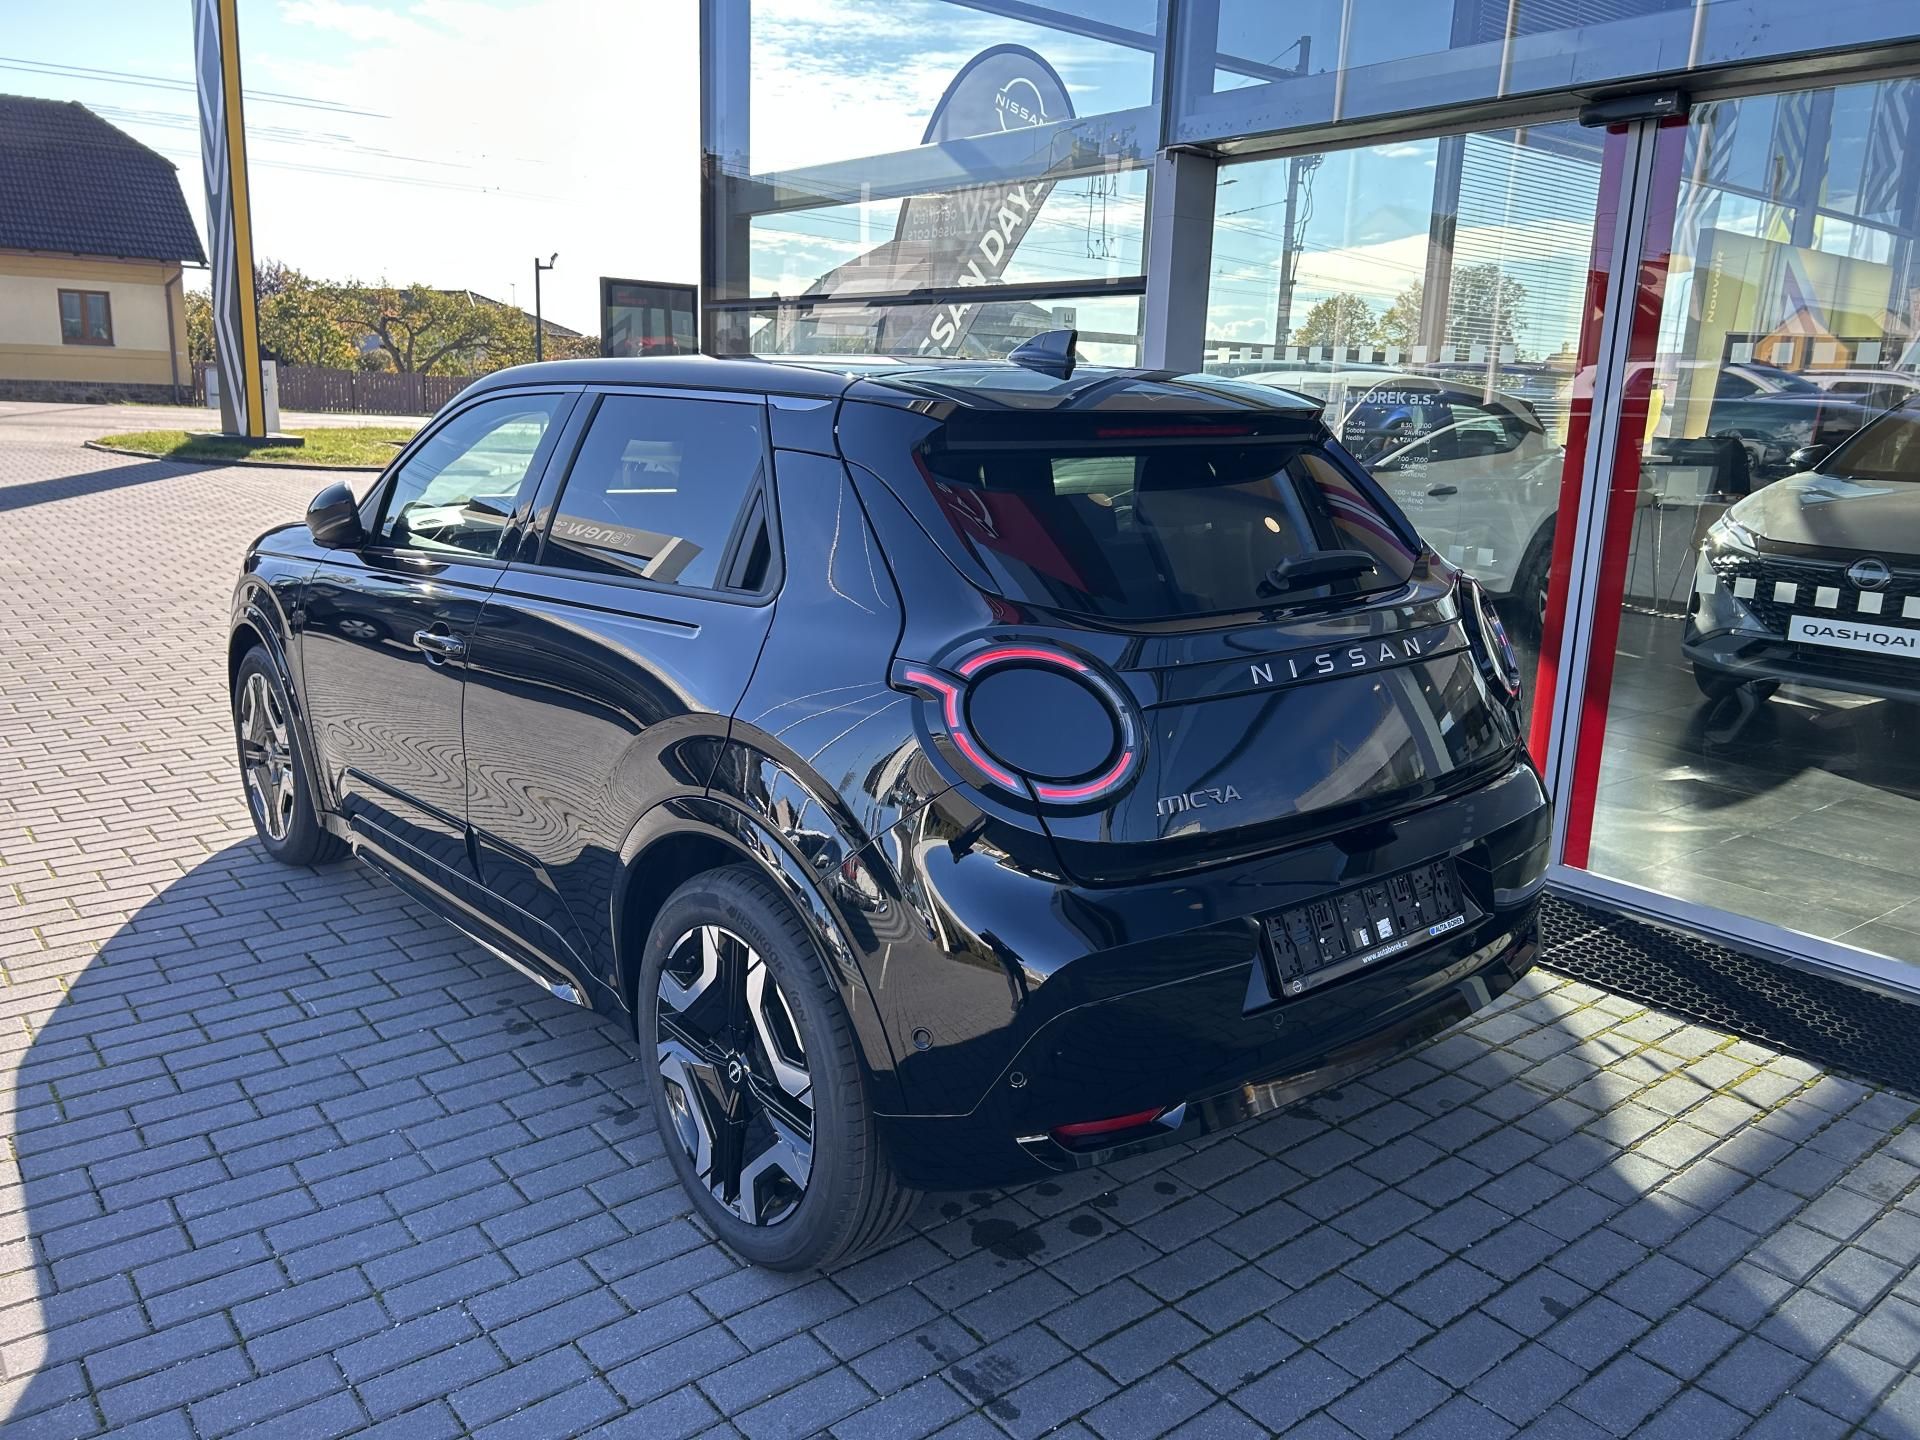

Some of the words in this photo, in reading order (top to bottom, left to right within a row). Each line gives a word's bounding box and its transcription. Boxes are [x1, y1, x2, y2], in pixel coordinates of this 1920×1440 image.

[979, 182, 1044, 266] DAY
[1356, 390, 1407, 405] BOREK
[1409, 393, 1435, 406] a.s.
[1802, 624, 1916, 648] QASHQAI
[1250, 637, 1422, 685] NISSAN
[1156, 784, 1243, 817] MICRA
[1361, 939, 1409, 964] www.autaborek.cz
